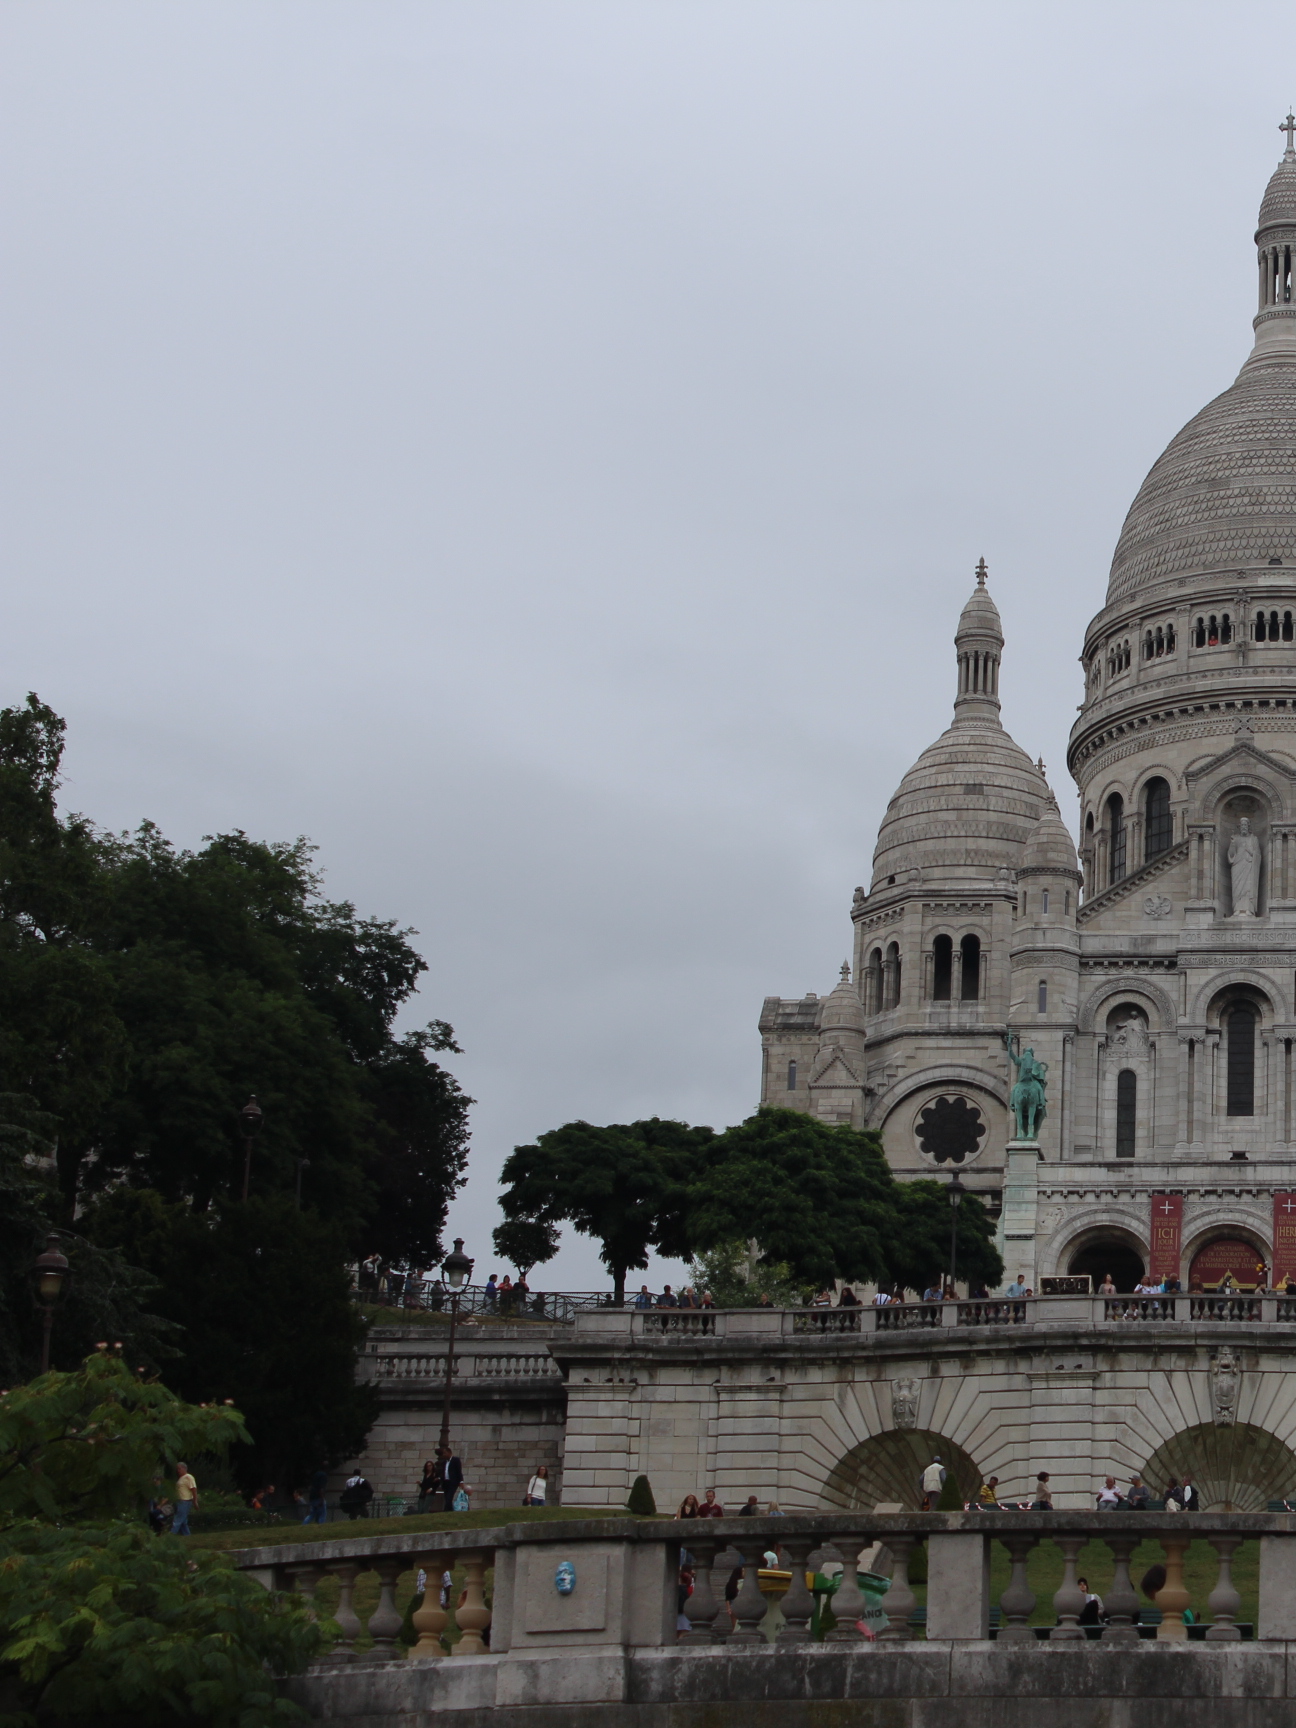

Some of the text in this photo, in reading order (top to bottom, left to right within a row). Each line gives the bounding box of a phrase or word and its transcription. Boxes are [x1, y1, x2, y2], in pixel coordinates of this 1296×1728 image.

[1186, 934, 1201, 942] COR
[1205, 934, 1226, 942] JESU
[1158, 1228, 1173, 1238] ICI
